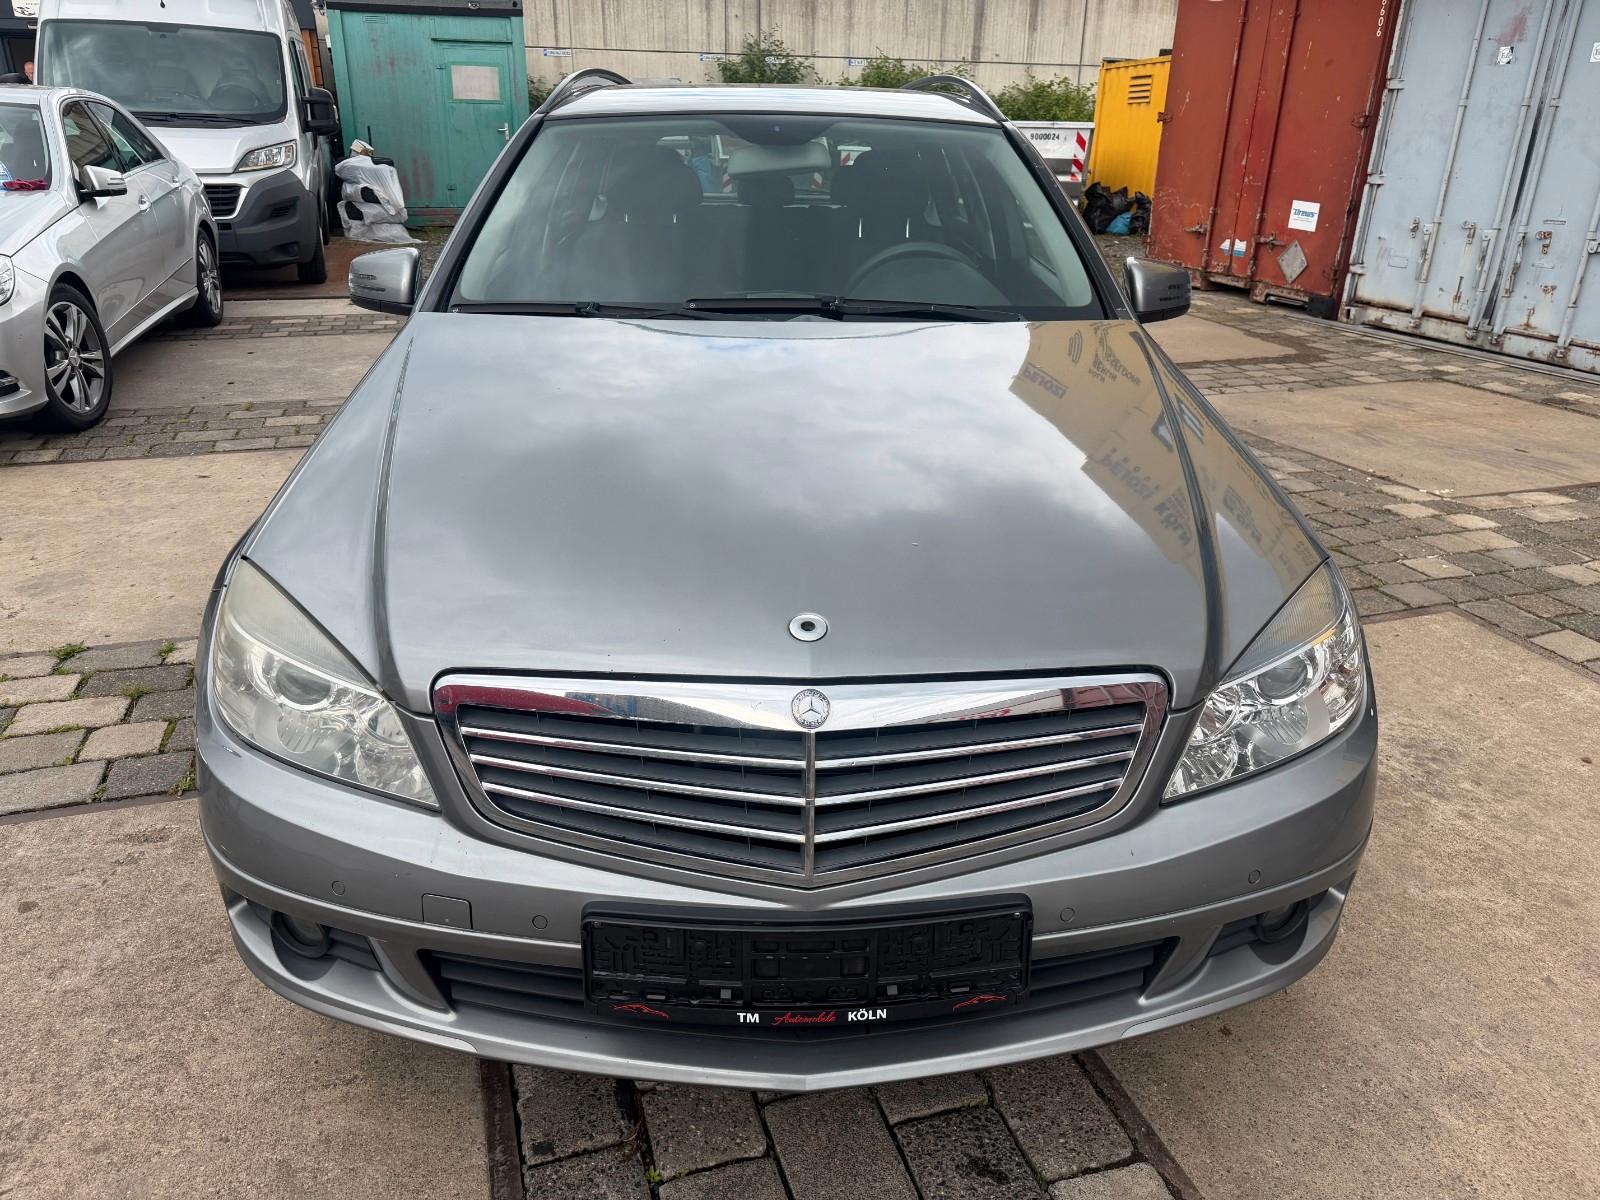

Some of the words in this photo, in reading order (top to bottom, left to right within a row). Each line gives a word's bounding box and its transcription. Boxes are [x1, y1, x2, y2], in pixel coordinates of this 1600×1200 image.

[1030, 132, 1060, 141] 9000024
[736, 1012, 760, 1024] TM
[771, 1010, 838, 1027] Automobile
[847, 1008, 888, 1023] KÖLN
